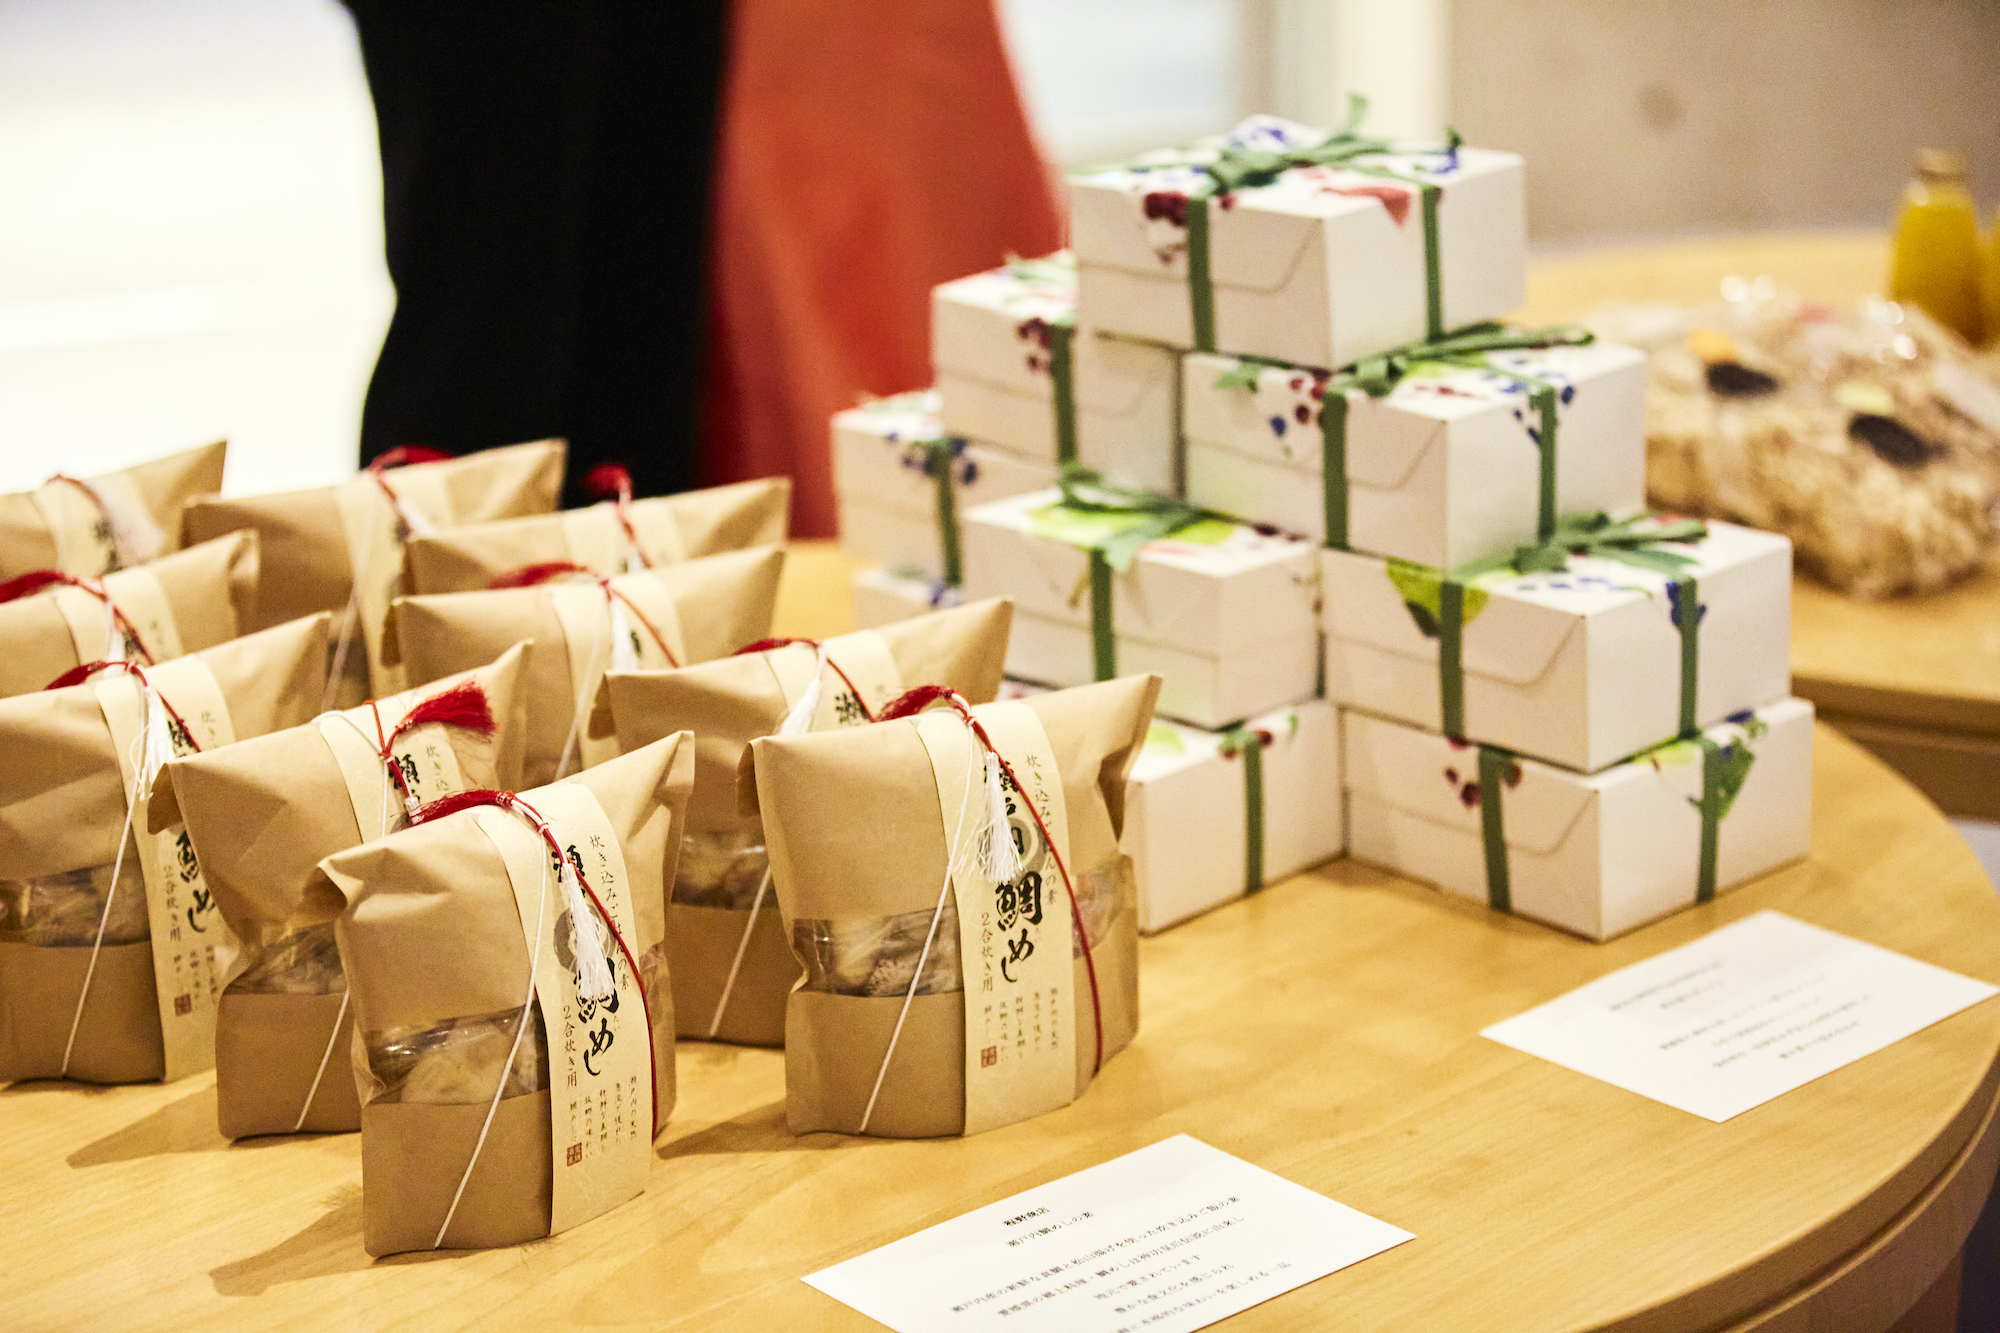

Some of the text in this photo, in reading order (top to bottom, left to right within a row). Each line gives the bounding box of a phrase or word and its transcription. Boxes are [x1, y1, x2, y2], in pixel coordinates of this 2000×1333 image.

[981, 913, 994, 993] 2合炊き用
[563, 1005, 578, 1089] 2合炊き用
